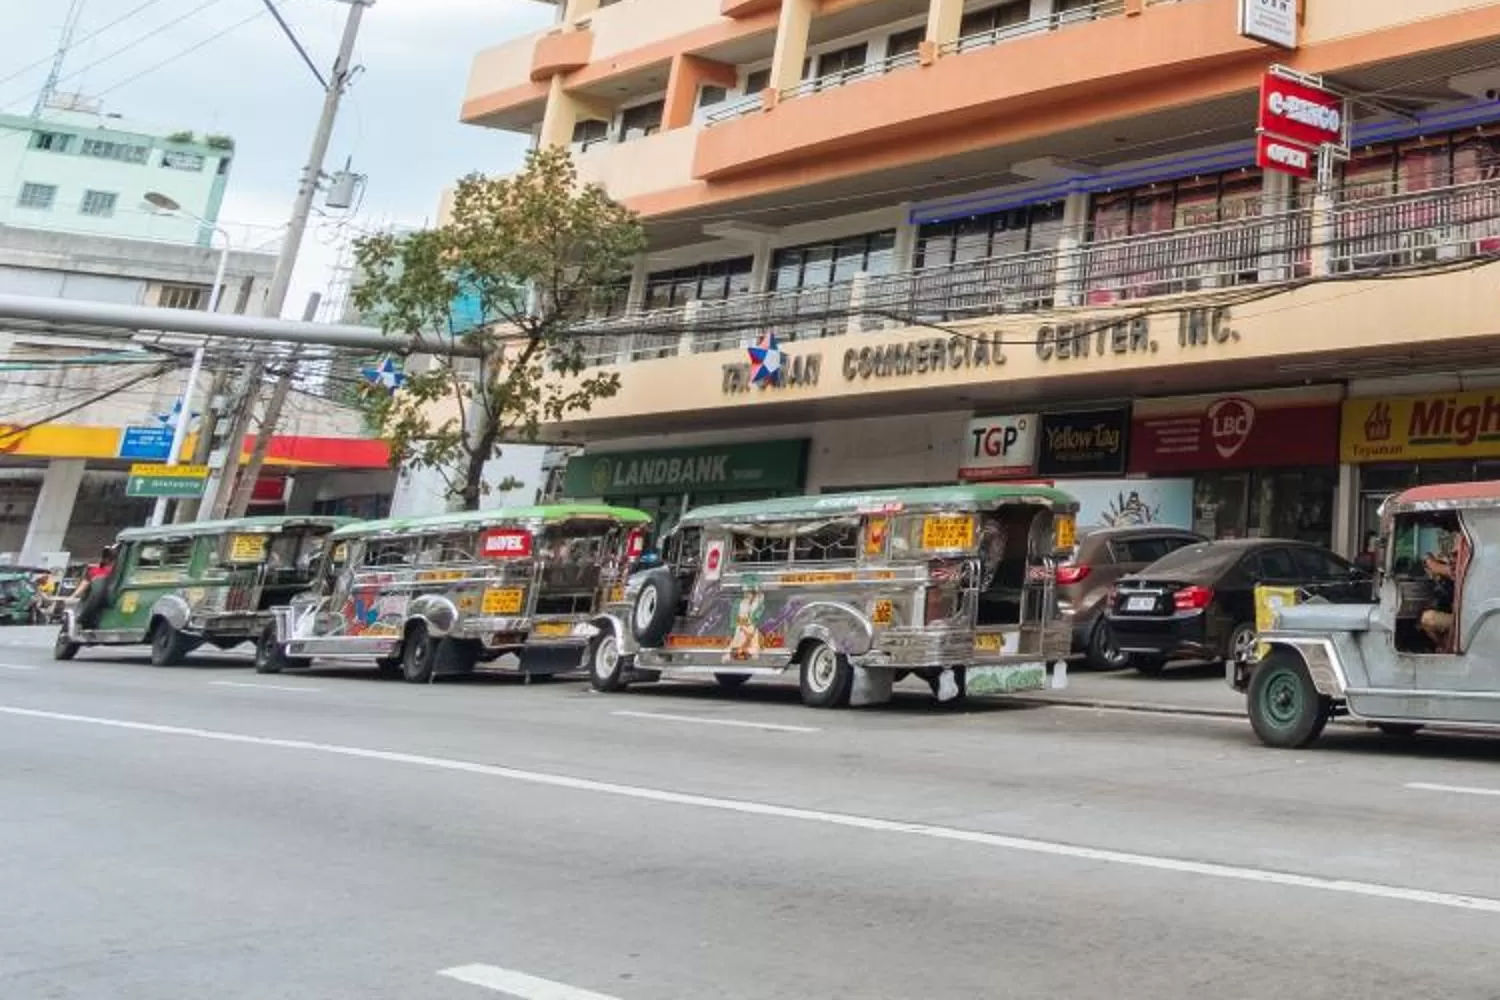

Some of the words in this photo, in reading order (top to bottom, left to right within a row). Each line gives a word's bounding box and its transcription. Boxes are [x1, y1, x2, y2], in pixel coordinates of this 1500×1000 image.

[842, 330, 1007, 381] COMMERCIAL
[972, 425, 1019, 457] TGP
[1212, 415, 1247, 437] LBC
[612, 455, 729, 486] LANDBANK
